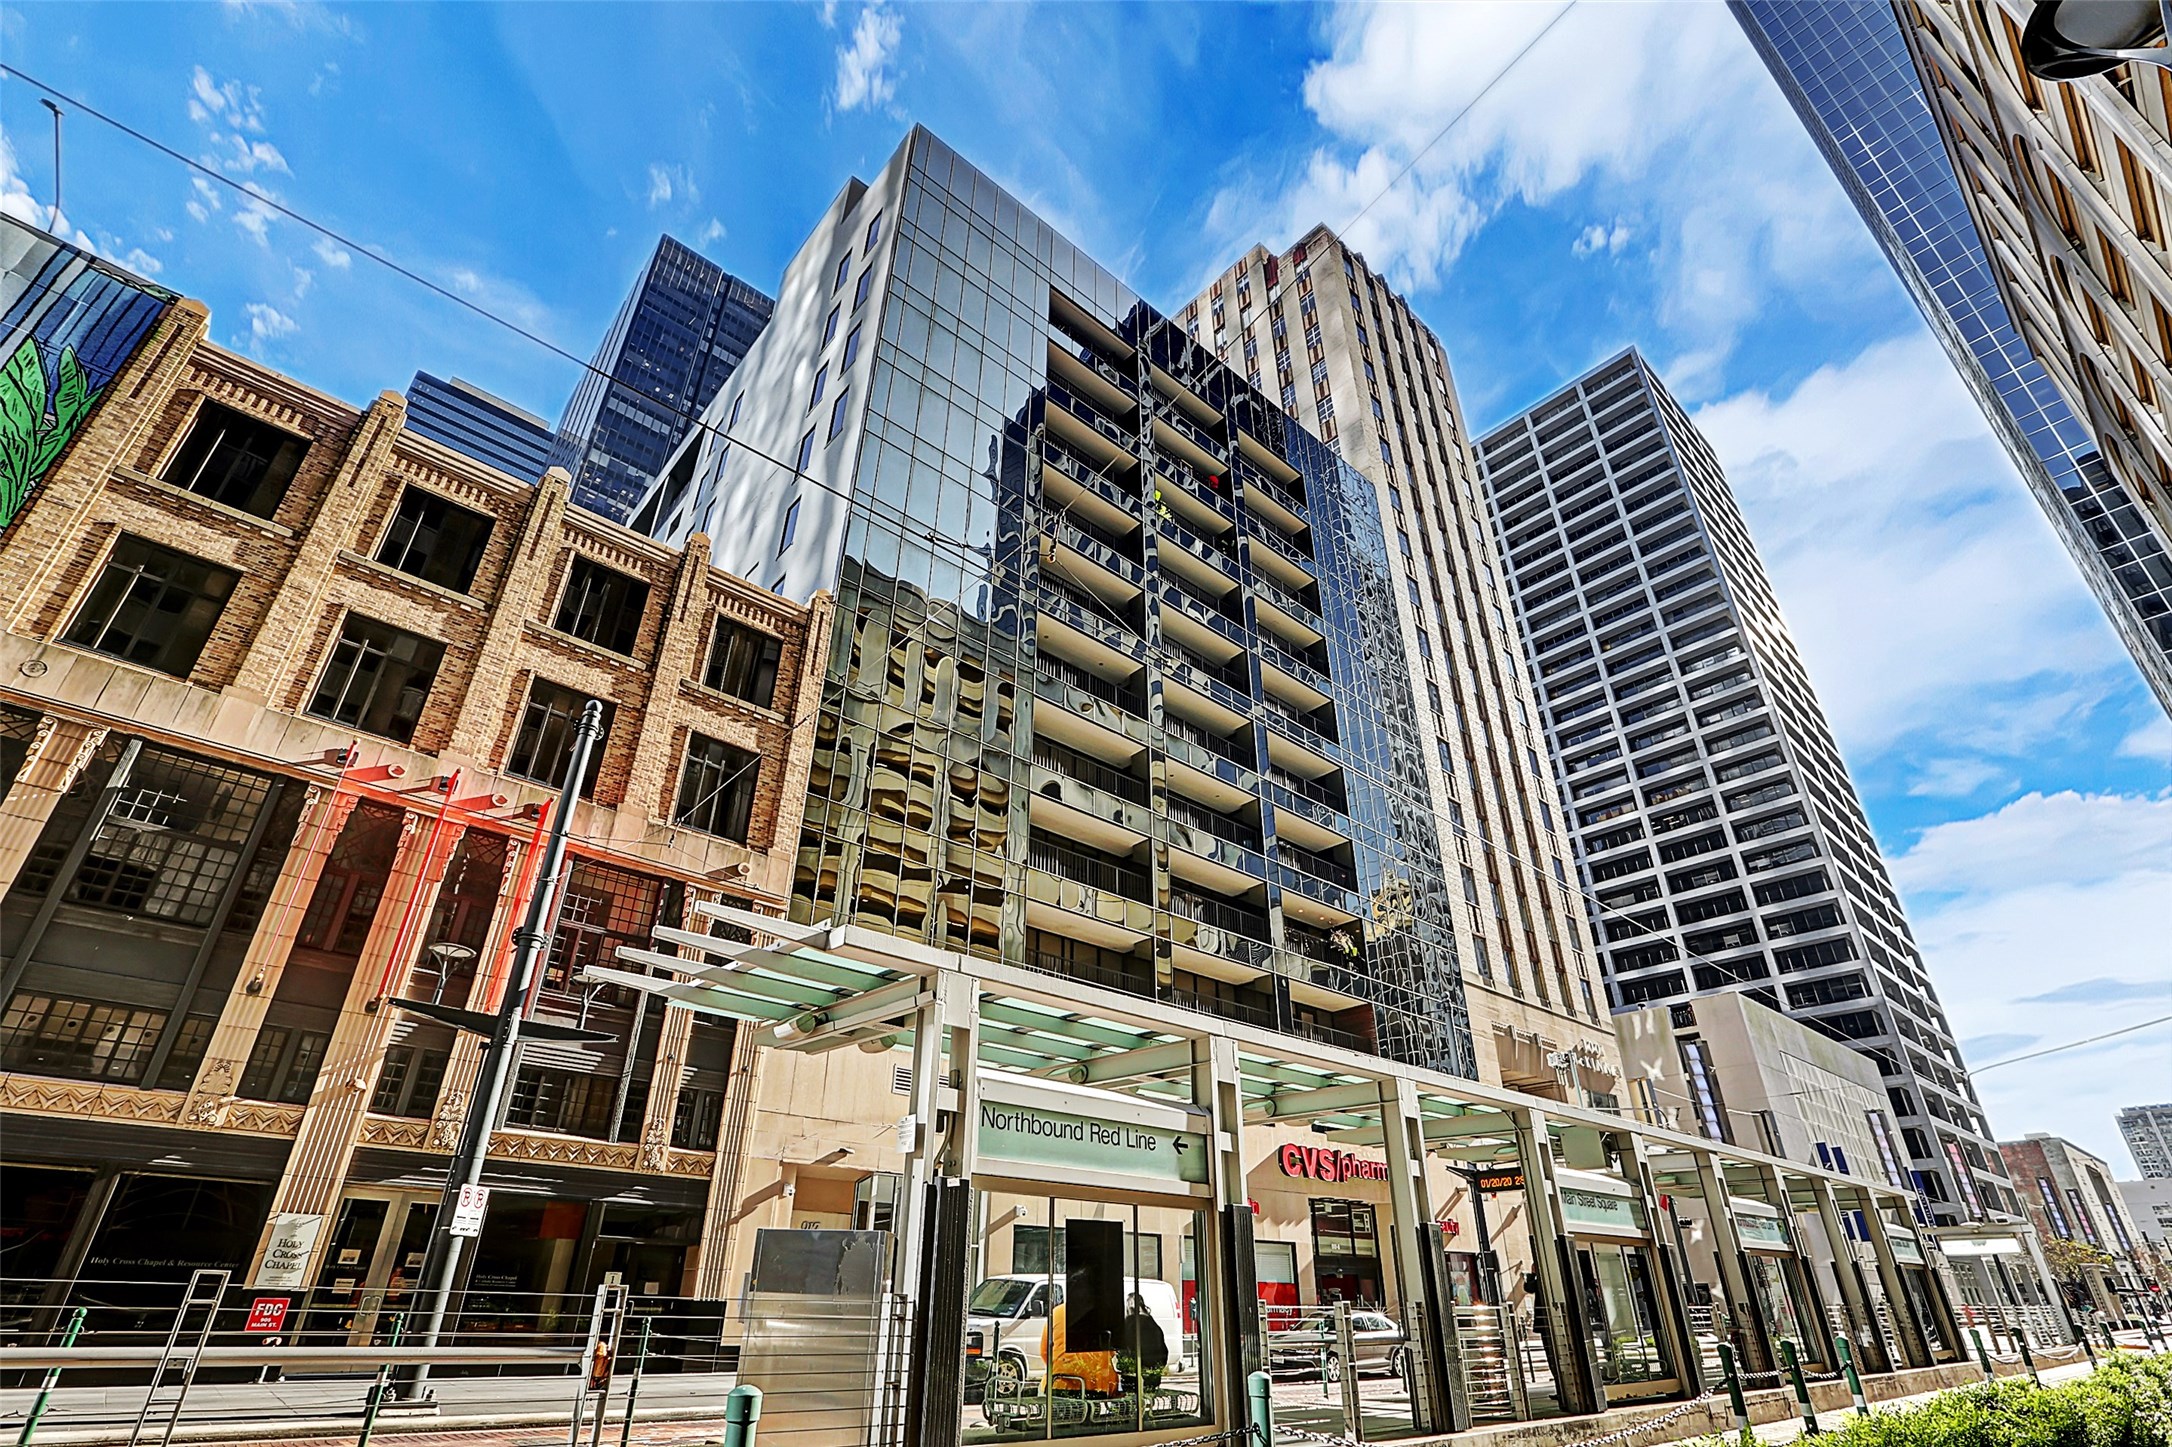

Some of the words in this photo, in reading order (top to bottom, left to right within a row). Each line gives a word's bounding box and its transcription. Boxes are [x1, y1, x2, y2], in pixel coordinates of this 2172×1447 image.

[981, 1105, 1084, 1142] Northbound
[1089, 1122, 1121, 1147] Red
[1126, 1127, 1157, 1151] Line
[1279, 1143, 1388, 1184] CVS/pharm
[1480, 1176, 1513, 1189] 01/20/20
[1560, 1190, 1577, 1206] Main
[1577, 1192, 1597, 1208] Street
[1596, 1195, 1618, 1213] Square
[277, 1238, 305, 1249] HOLY
[272, 1248, 302, 1260] CROSS
[90, 1256, 110, 1267] Holy
[112, 1257, 136, 1266] Cross
[137, 1257, 167, 1268] Chapel
[167, 1259, 175, 1267] &
[177, 1259, 213, 1268] Resource
[214, 1260, 240, 1269] Center
[264, 1259, 302, 1270] CHAPEL
[255, 1303, 284, 1316] FDC
